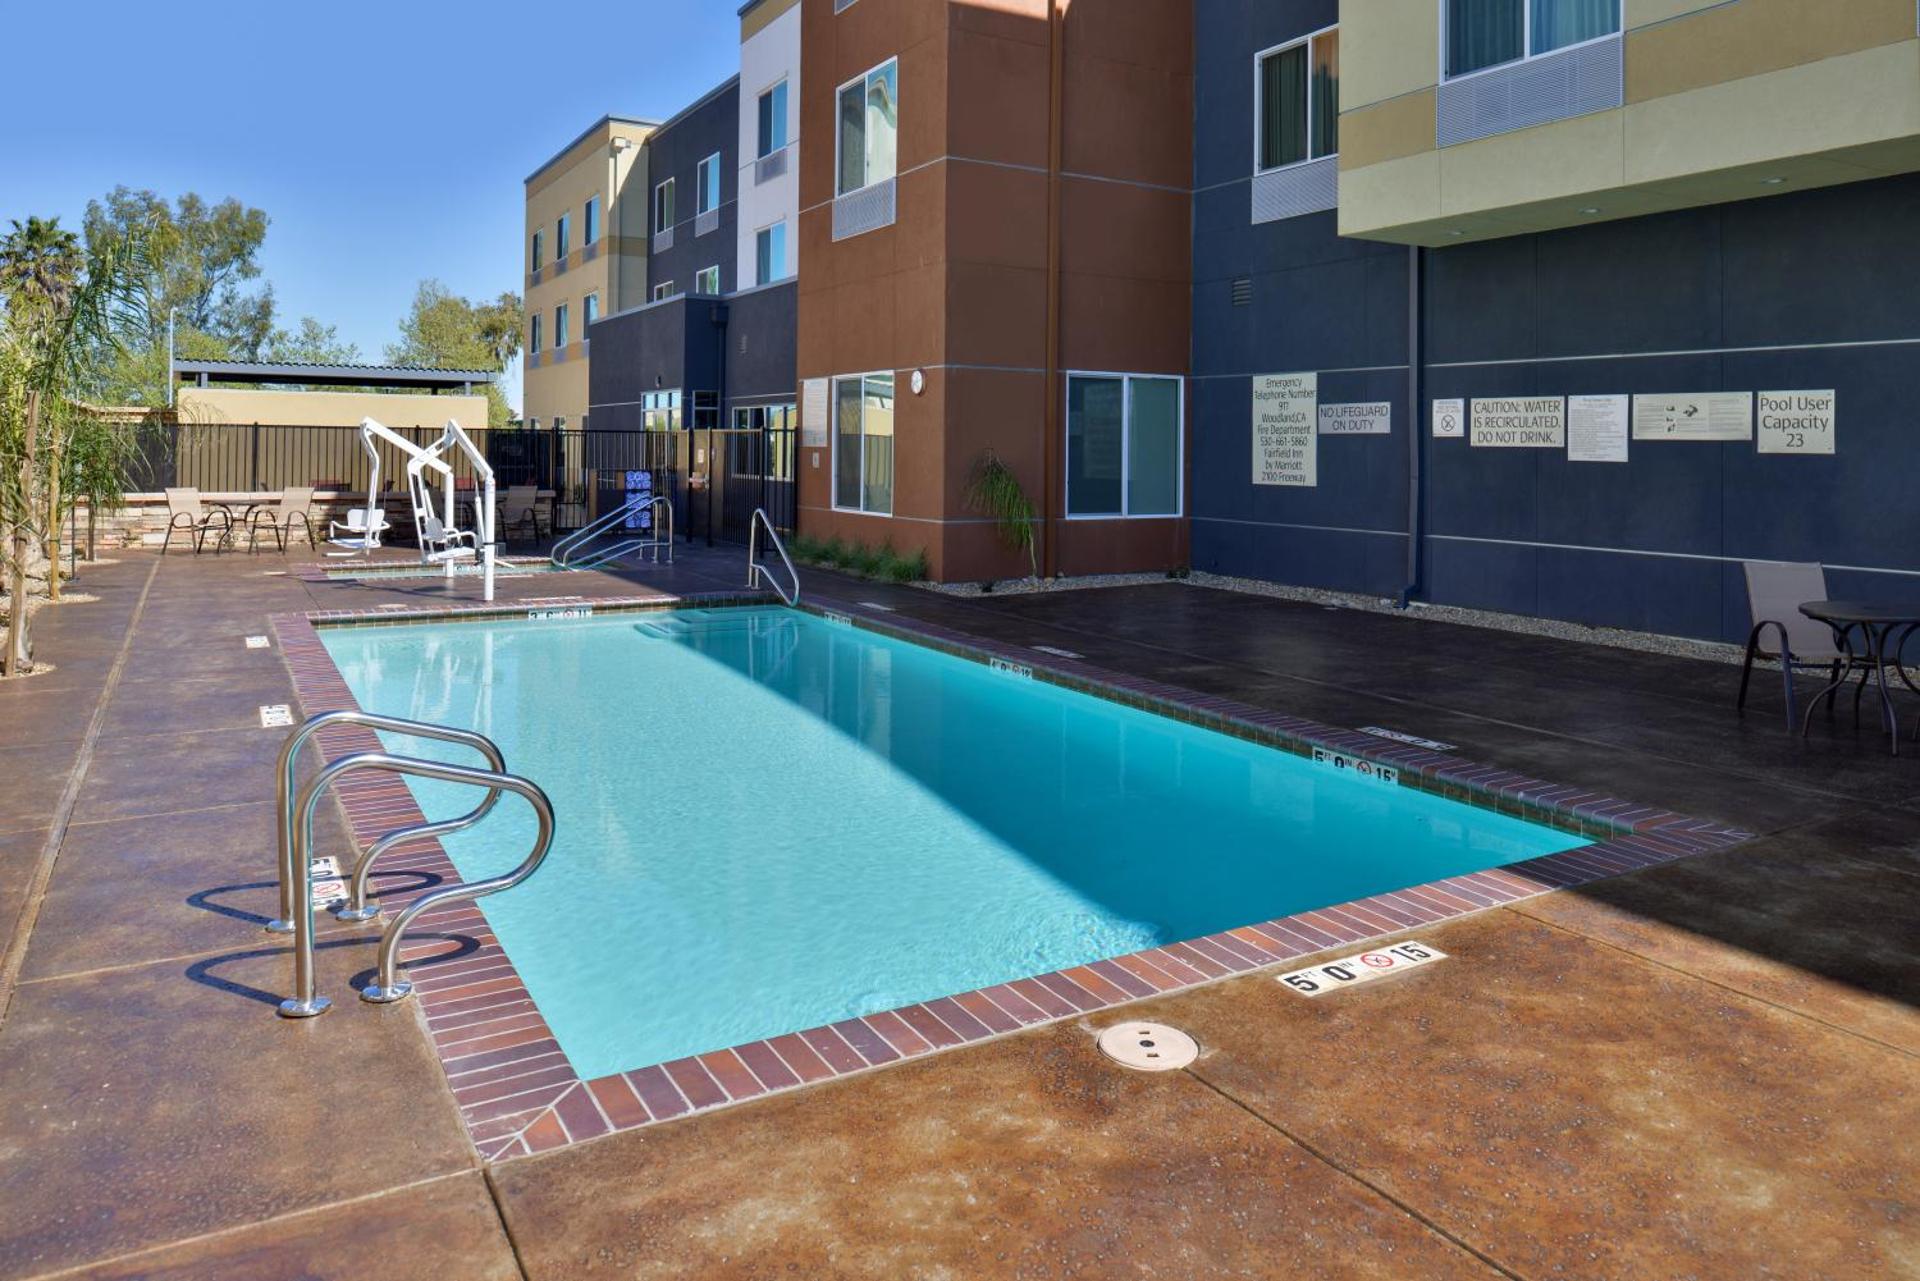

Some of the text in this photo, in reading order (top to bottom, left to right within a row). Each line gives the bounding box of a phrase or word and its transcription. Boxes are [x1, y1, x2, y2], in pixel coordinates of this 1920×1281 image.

[1266, 378, 1303, 390] Emergency
[1288, 389, 1315, 399] Number
[1524, 401, 1561, 413] WATER
[1760, 396, 1831, 411] Pool User
[1320, 405, 1388, 418] NO LIFEGUARD
[1332, 419, 1374, 431] ON DUTY
[1474, 416, 1561, 428] IS RECIRCULATED.
[1763, 414, 1829, 432] Capacity
[1258, 424, 1311, 435] Fire Department
[1478, 431, 1556, 443] DO NOT DRINK.
[1786, 433, 1804, 447] 23
[1264, 448, 1304, 458] Fairfield Inn
[1275, 460, 1303, 470] Marriott
[1283, 975, 1319, 992] 5
[1322, 965, 1356, 981] 0
